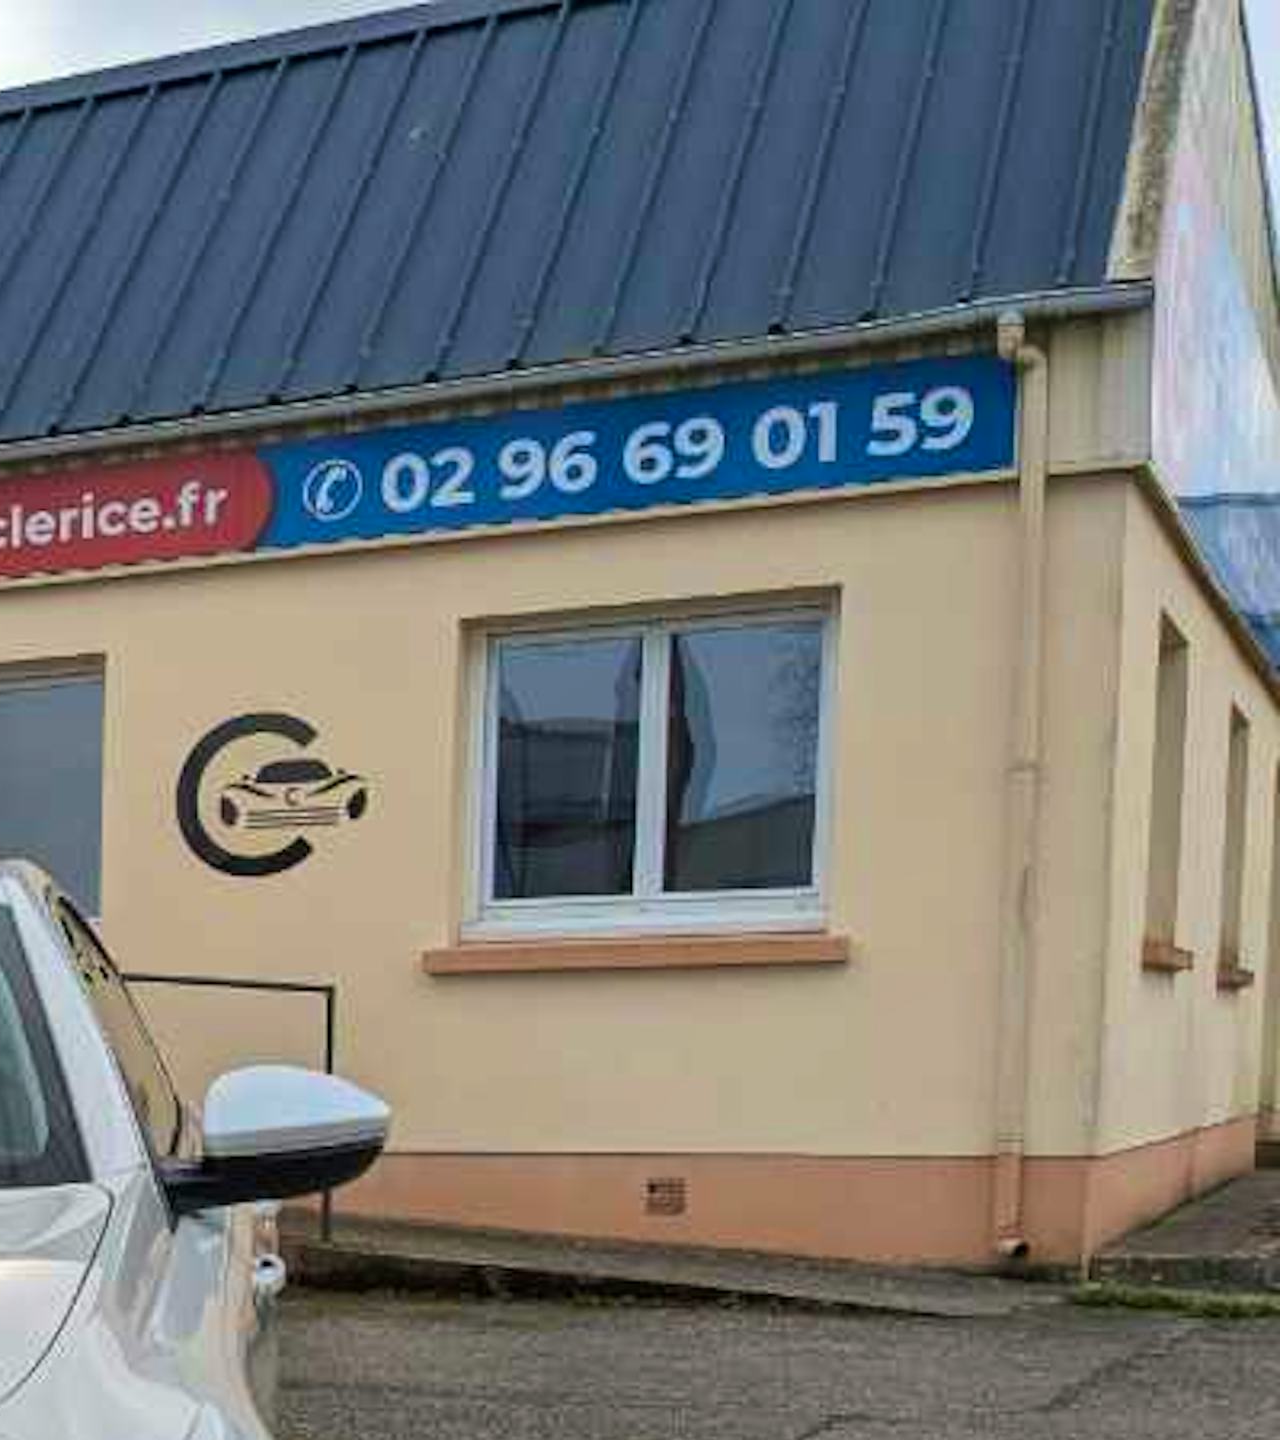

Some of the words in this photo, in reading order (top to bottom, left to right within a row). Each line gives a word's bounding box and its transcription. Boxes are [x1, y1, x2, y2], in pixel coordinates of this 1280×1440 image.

[380, 445, 475, 512] 02
[497, 430, 598, 499] 96
[623, 416, 725, 484] 69
[752, 400, 838, 470] 01
[867, 385, 975, 456] 59
